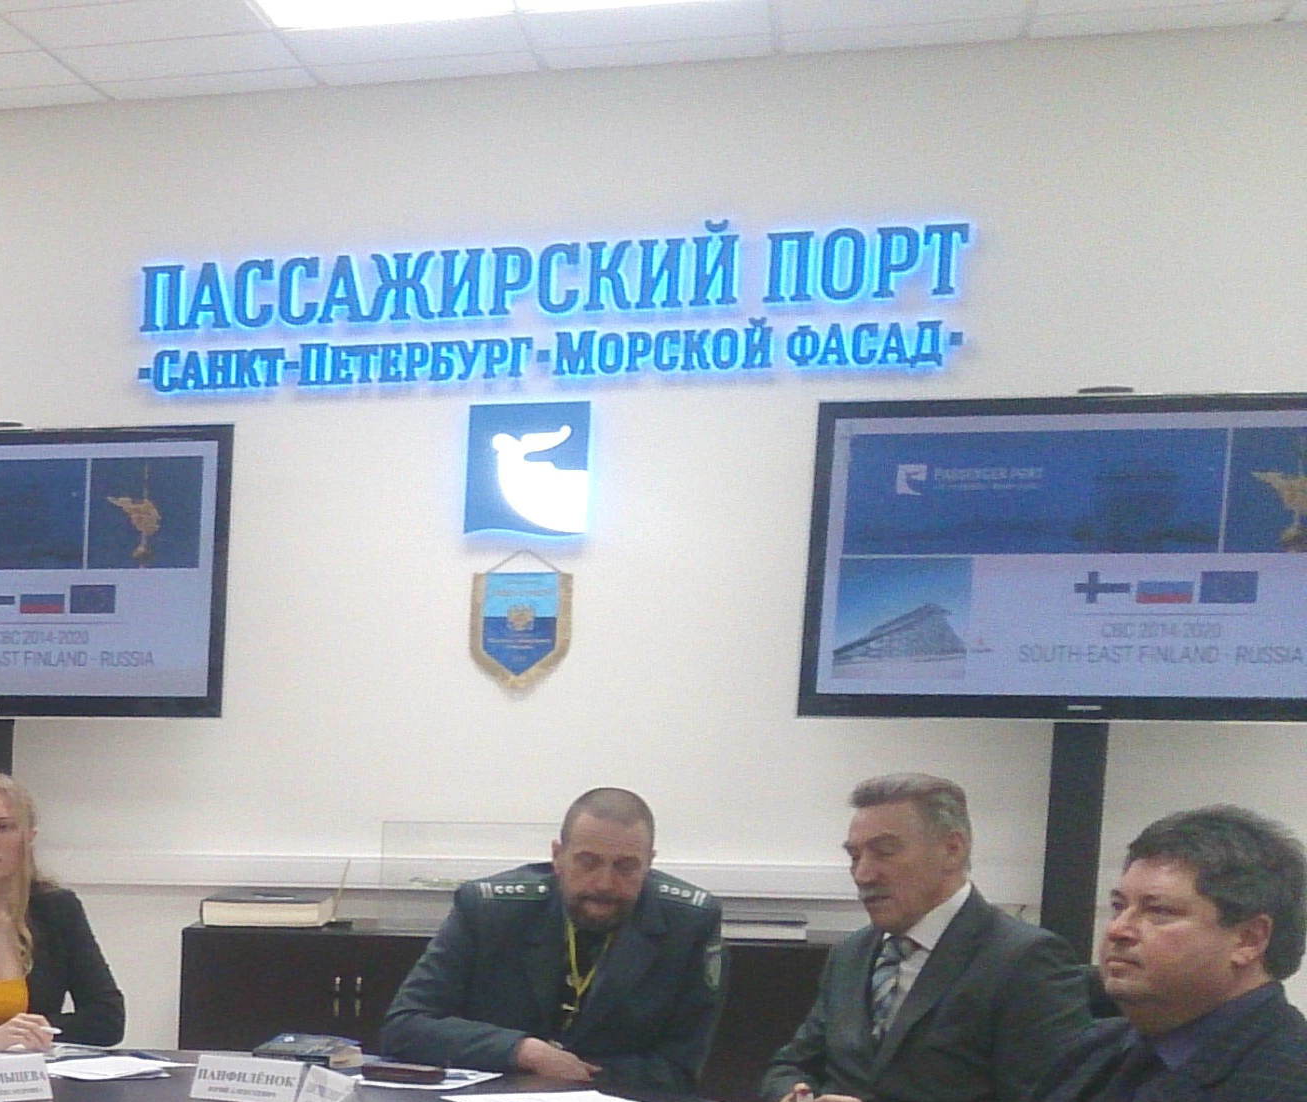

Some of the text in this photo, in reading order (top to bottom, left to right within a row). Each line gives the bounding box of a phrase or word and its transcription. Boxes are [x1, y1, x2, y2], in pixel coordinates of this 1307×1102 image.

[140, 219, 969, 332] ПАССАЖИРСКИЙ ПОРТ
[101, 650, 155, 667] RUSSIA
[1235, 644, 1304, 665] RUSSIA
[197, 1068, 297, 1087] ПАНФИЛЁНОК
